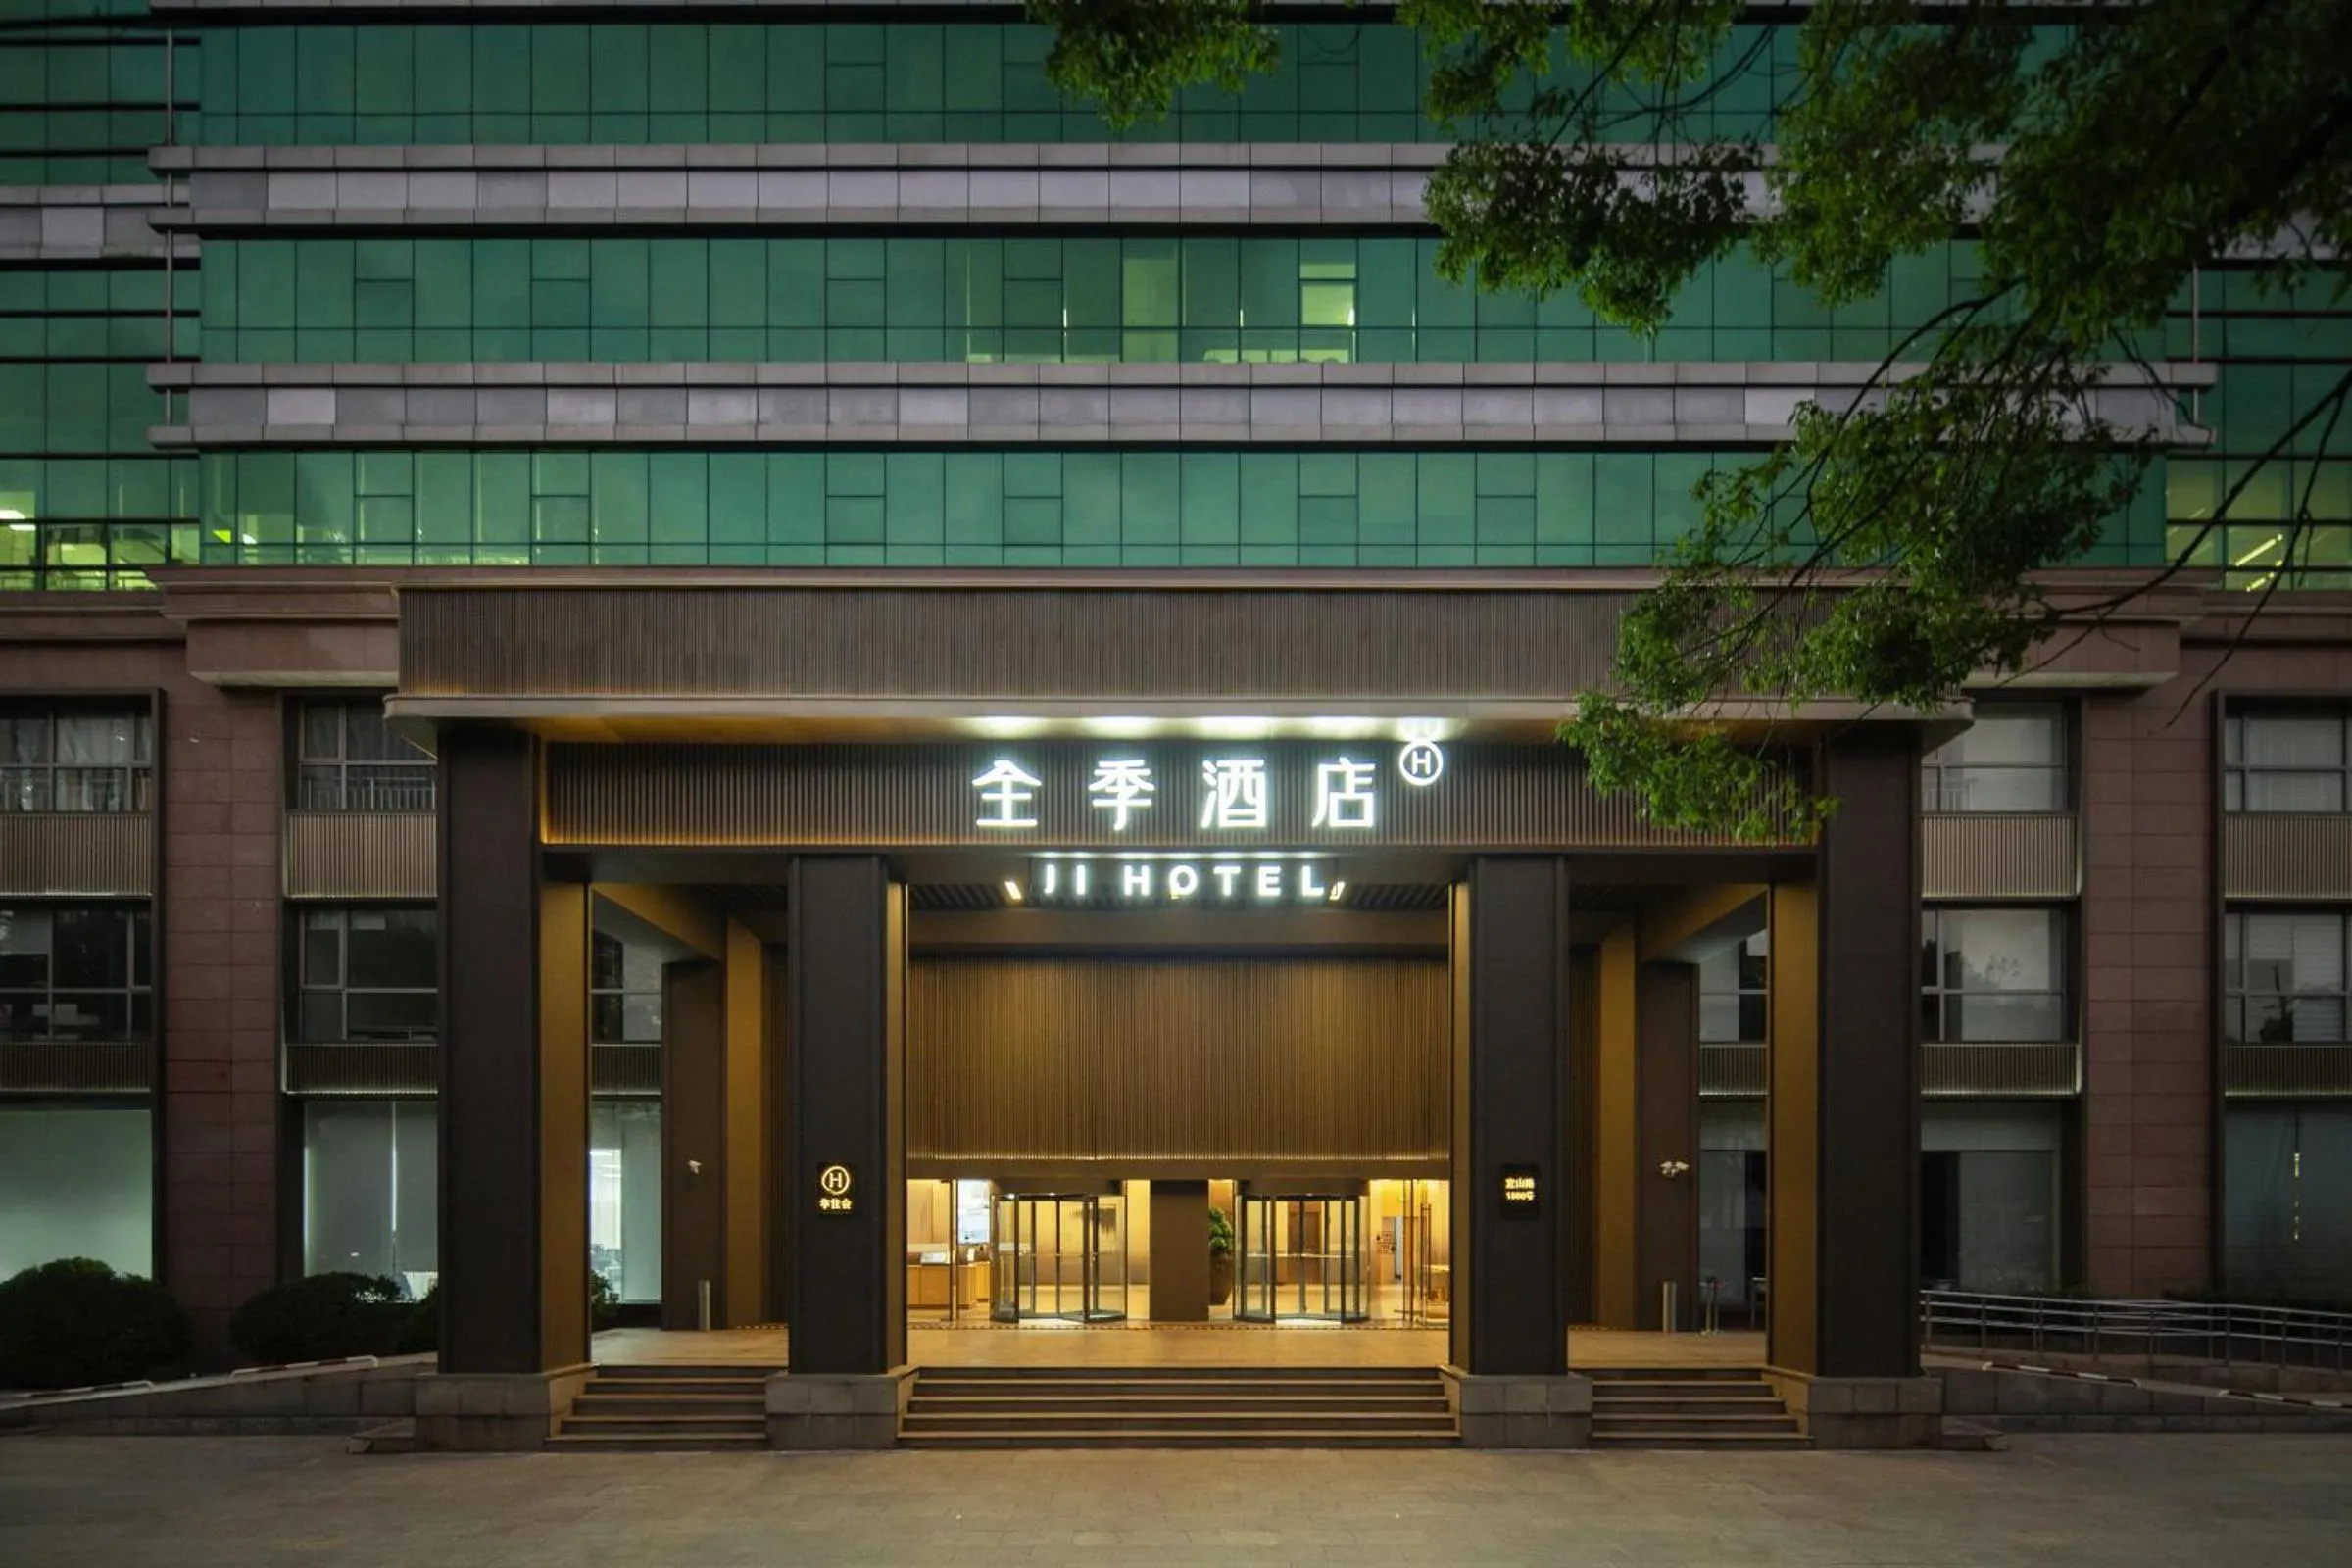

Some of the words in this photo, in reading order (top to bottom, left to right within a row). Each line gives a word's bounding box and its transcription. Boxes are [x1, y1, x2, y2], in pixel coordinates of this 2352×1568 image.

[971, 757, 1376, 831] 全季酒店
[1044, 863, 1086, 896] JI
[1123, 864, 1325, 897] HOTEL
